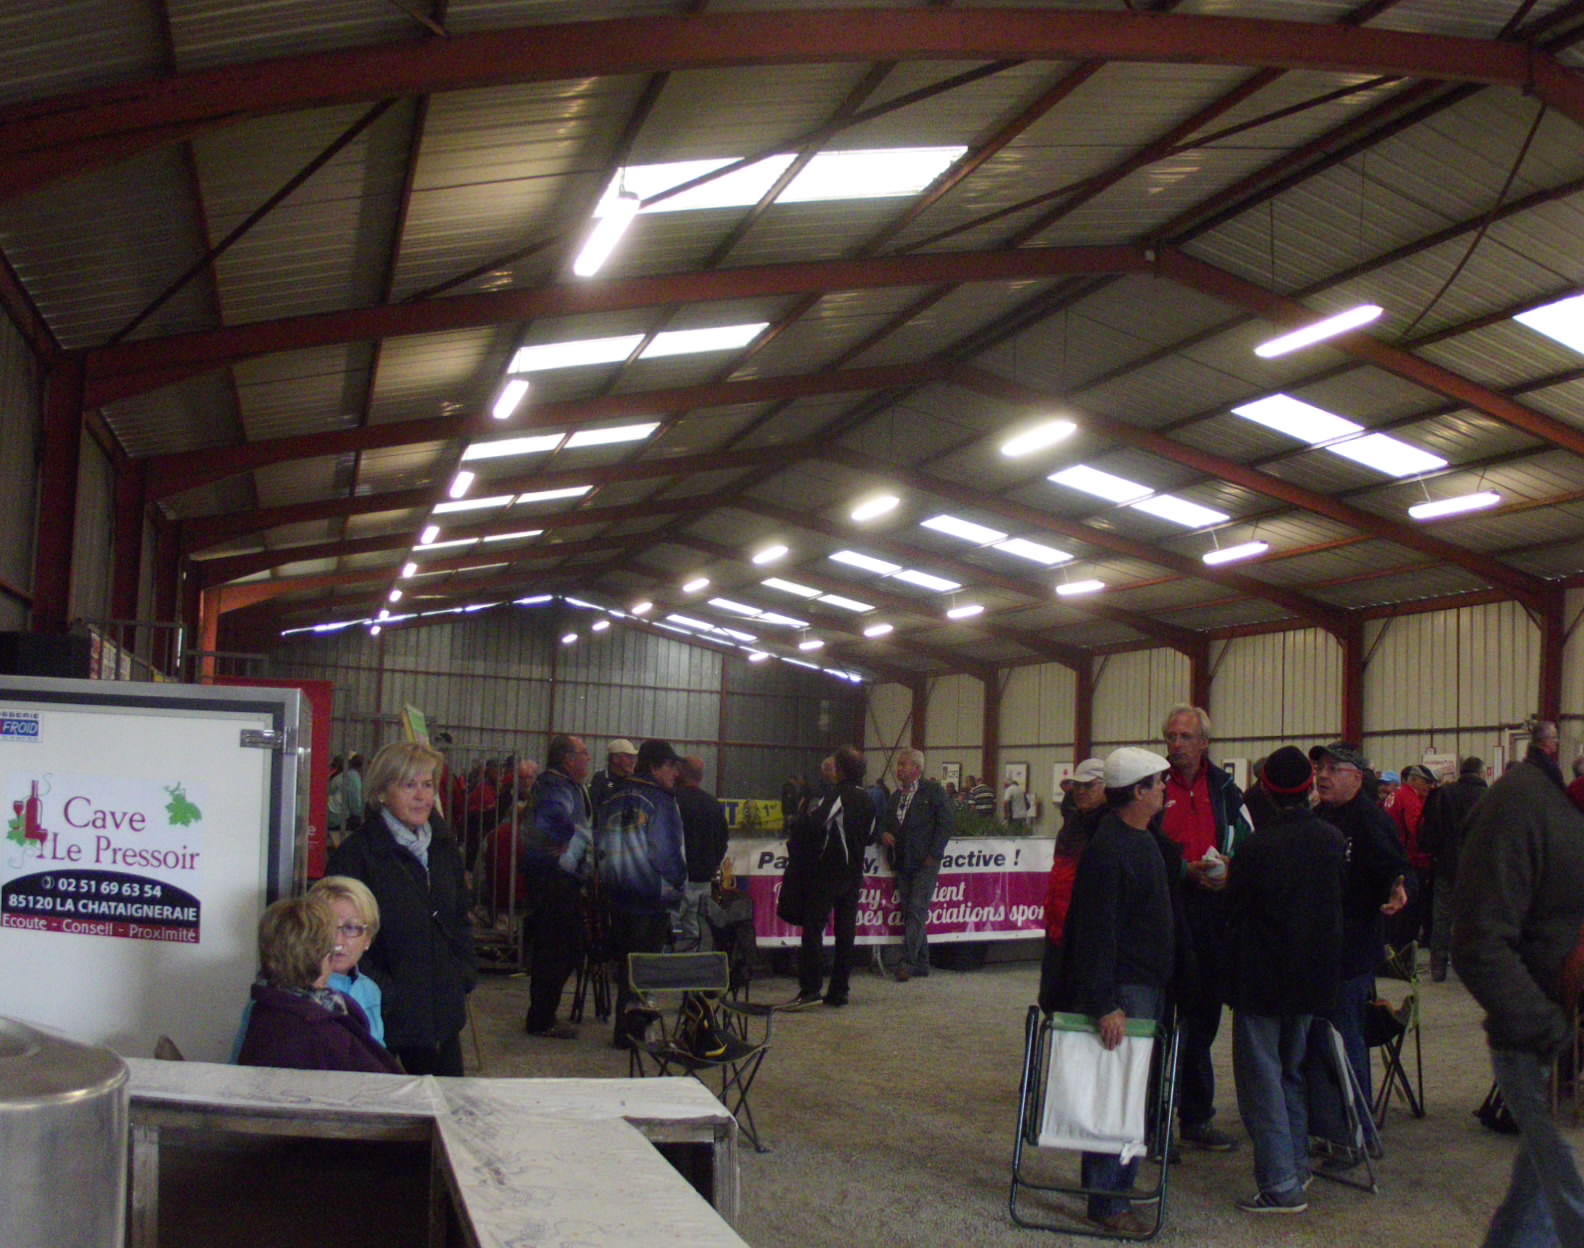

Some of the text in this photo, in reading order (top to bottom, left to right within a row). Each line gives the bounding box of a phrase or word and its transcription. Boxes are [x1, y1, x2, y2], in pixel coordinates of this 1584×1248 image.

[63, 795, 147, 832] Cave
[51, 832, 201, 871] Le Pressoir
[58, 878, 162, 898] 02 51 69 63 54
[8, 894, 197, 921] 85120 LA CHATAIGNERAIE
[62, 919, 113, 936] Conseil
[129, 924, 196, 942] Proximité
